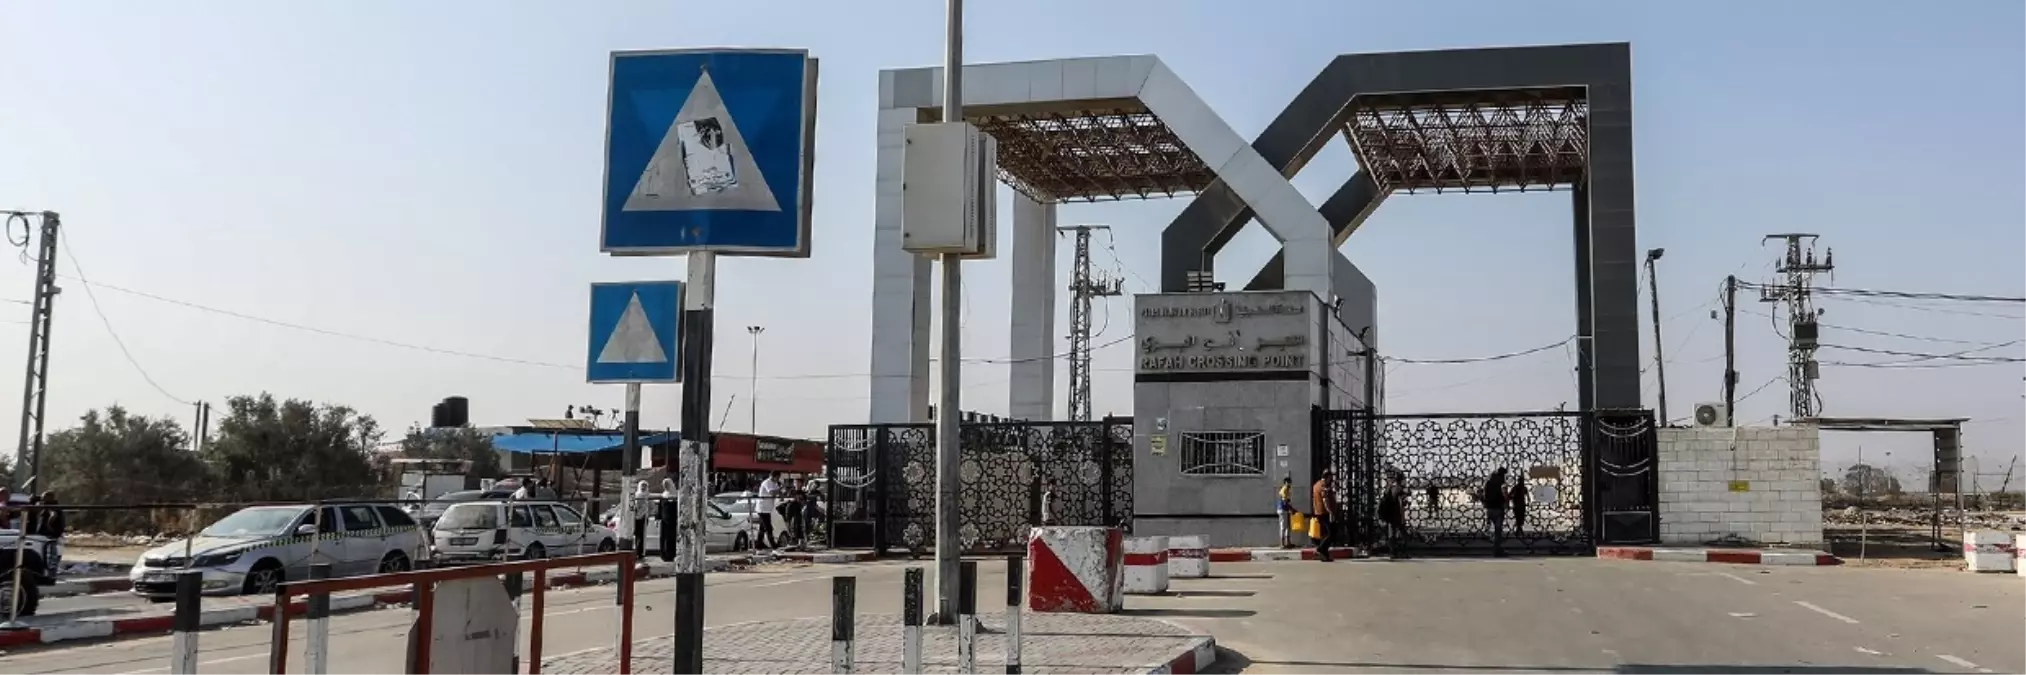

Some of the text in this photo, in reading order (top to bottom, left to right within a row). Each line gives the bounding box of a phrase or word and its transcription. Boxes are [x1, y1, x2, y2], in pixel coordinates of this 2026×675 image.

[1141, 354, 1305, 369] RAFAH CROSSING POINT
